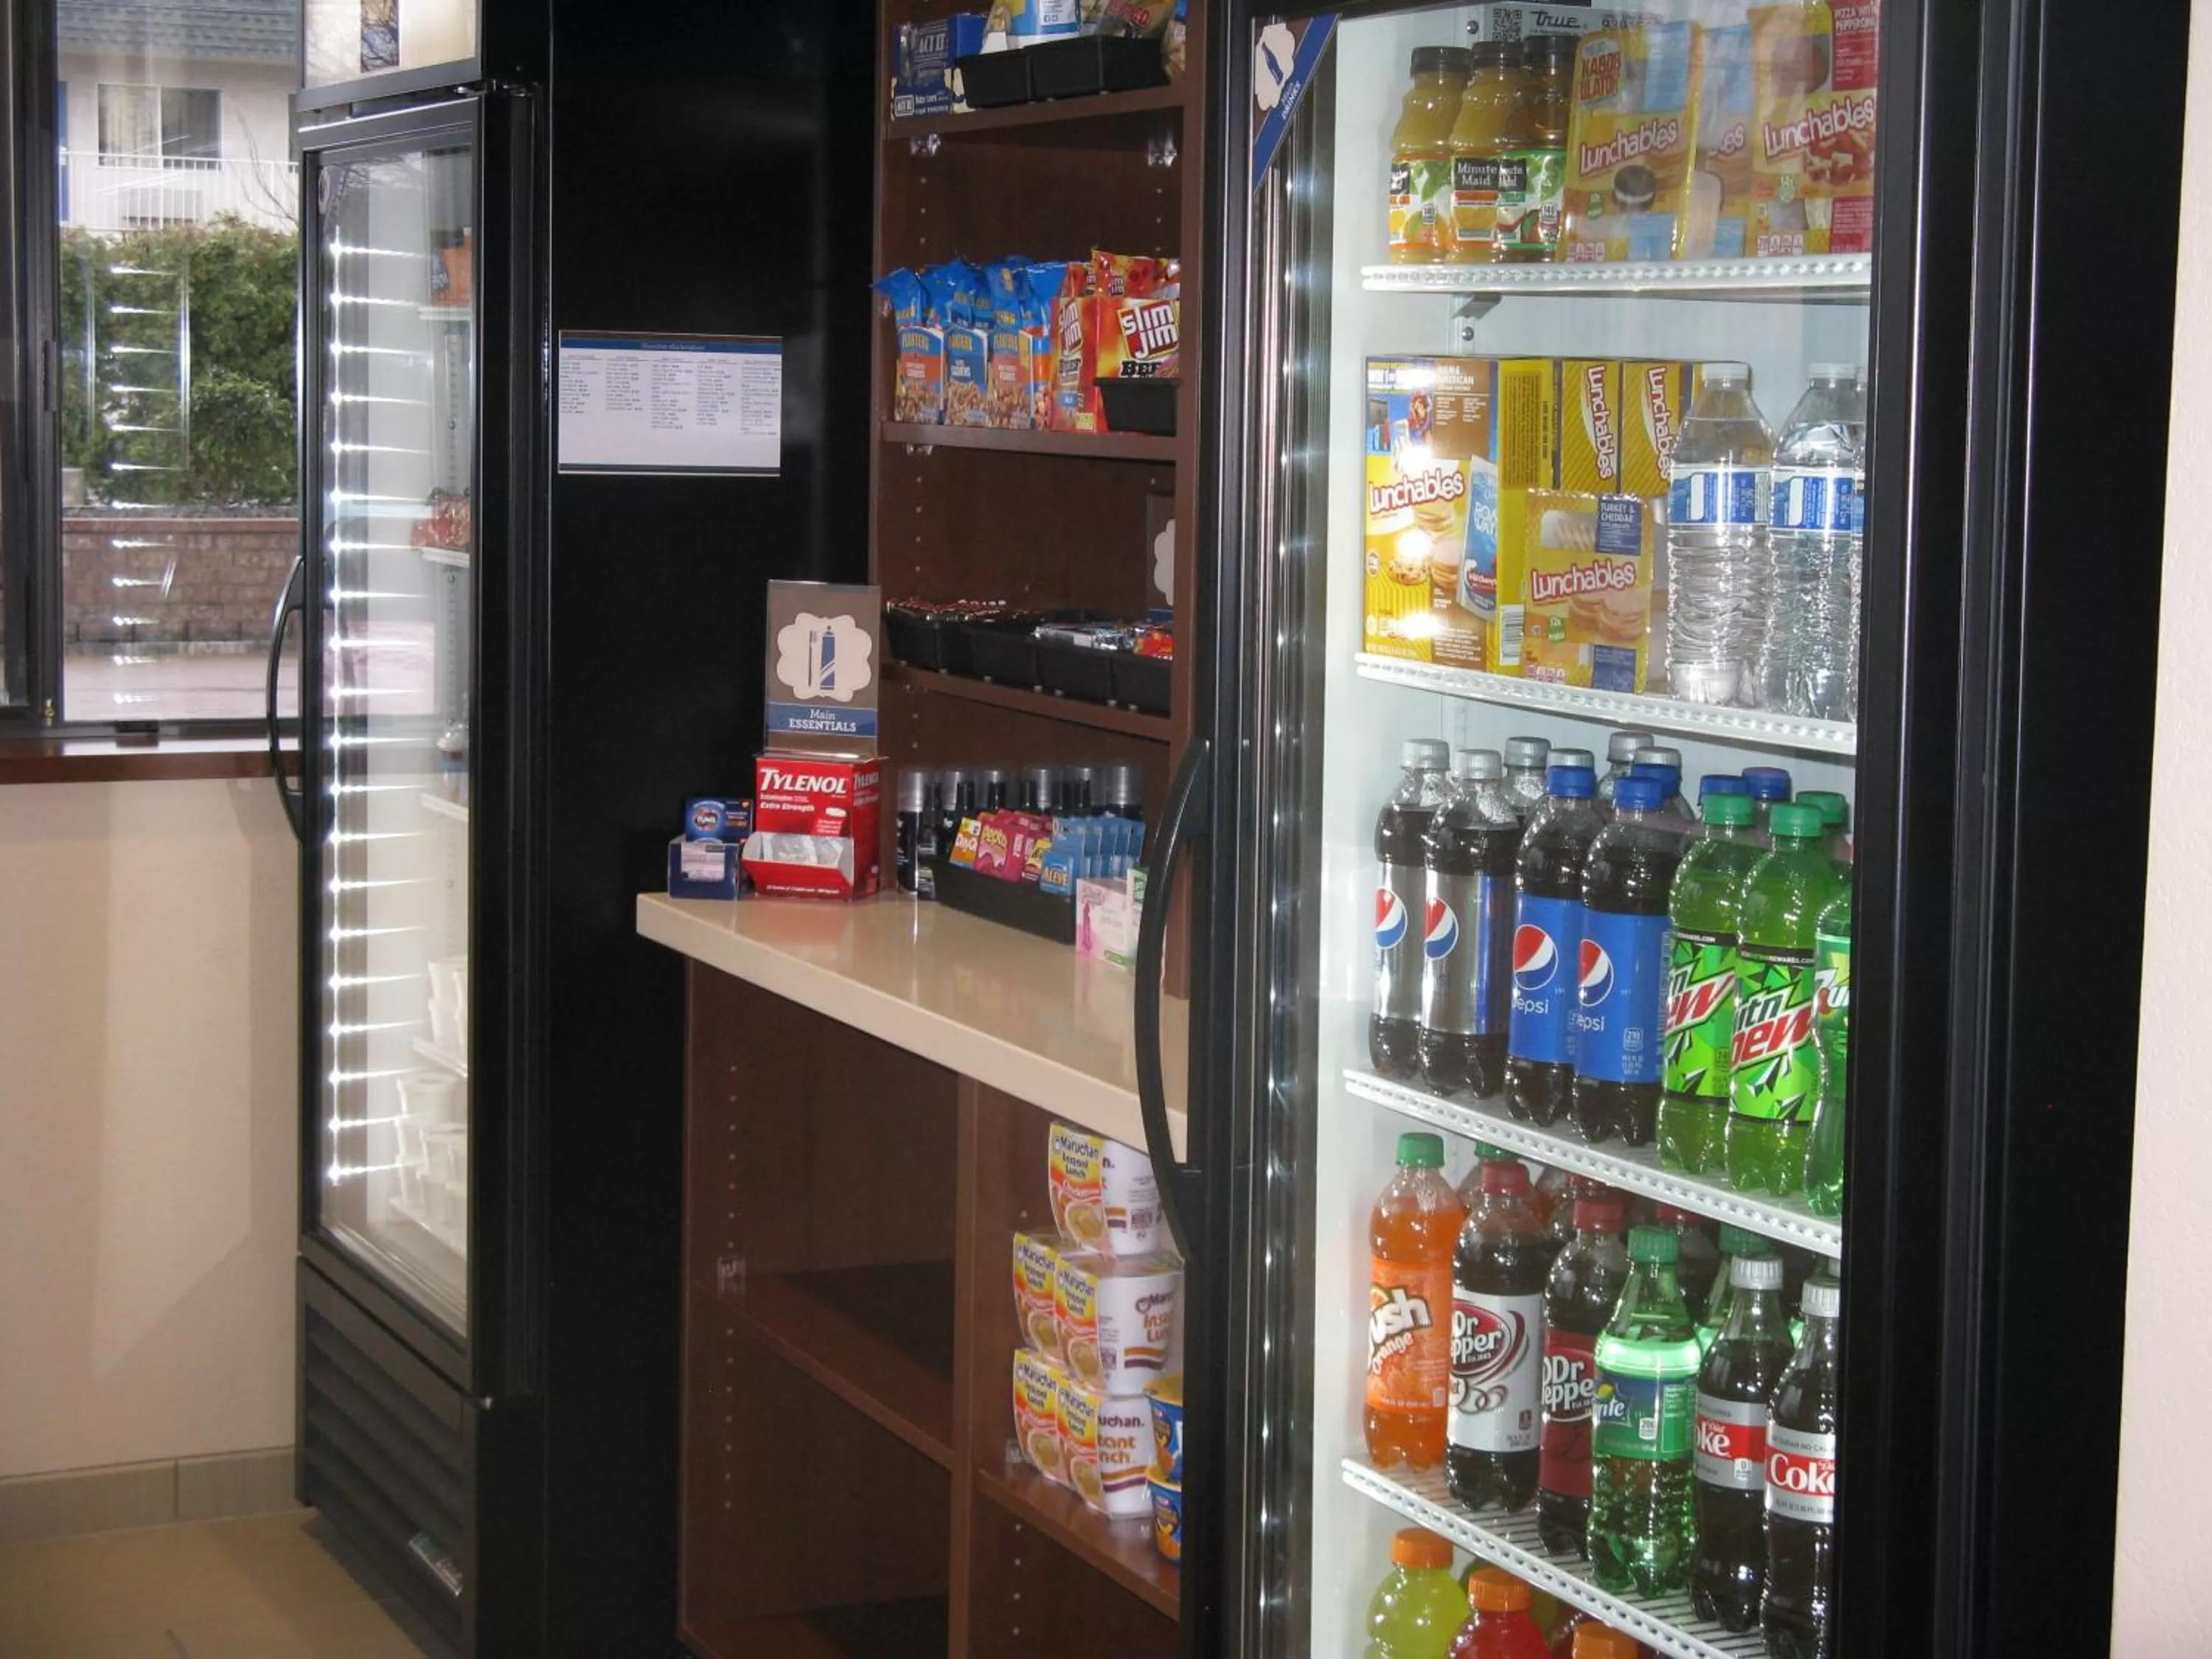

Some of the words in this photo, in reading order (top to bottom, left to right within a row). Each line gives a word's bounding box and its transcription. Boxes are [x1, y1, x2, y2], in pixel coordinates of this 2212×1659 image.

[1764, 97, 1875, 155] Lunchables
[1580, 119, 1678, 175] Lunchables
[1458, 162, 1498, 176] Minute
[1462, 174, 1492, 187] Maid
[1587, 365, 1615, 479] Lunchables
[1368, 467, 1464, 512] Lunchables
[1601, 502, 1627, 513] TURKEY
[1531, 558, 1635, 601] Lunchables
[810, 709, 835, 720] Main
[789, 718, 857, 732] ESSENTIALS
[760, 767, 847, 794] TYLENOL
[760, 801, 780, 810] Extra
[782, 801, 815, 813] Strength
[1577, 1015, 1605, 1032] epsi
[1060, 1135, 1099, 1160] Maruchan
[1065, 1164, 1086, 1180] Lunch
[1452, 1329, 1502, 1365] pper
[1552, 1355, 1585, 1381] Dr
[1099, 1415, 1144, 1428] uchan.
[1099, 1435, 1136, 1450] tant
[1697, 1422, 1731, 1457] ke
[1099, 1450, 1130, 1464] nch
